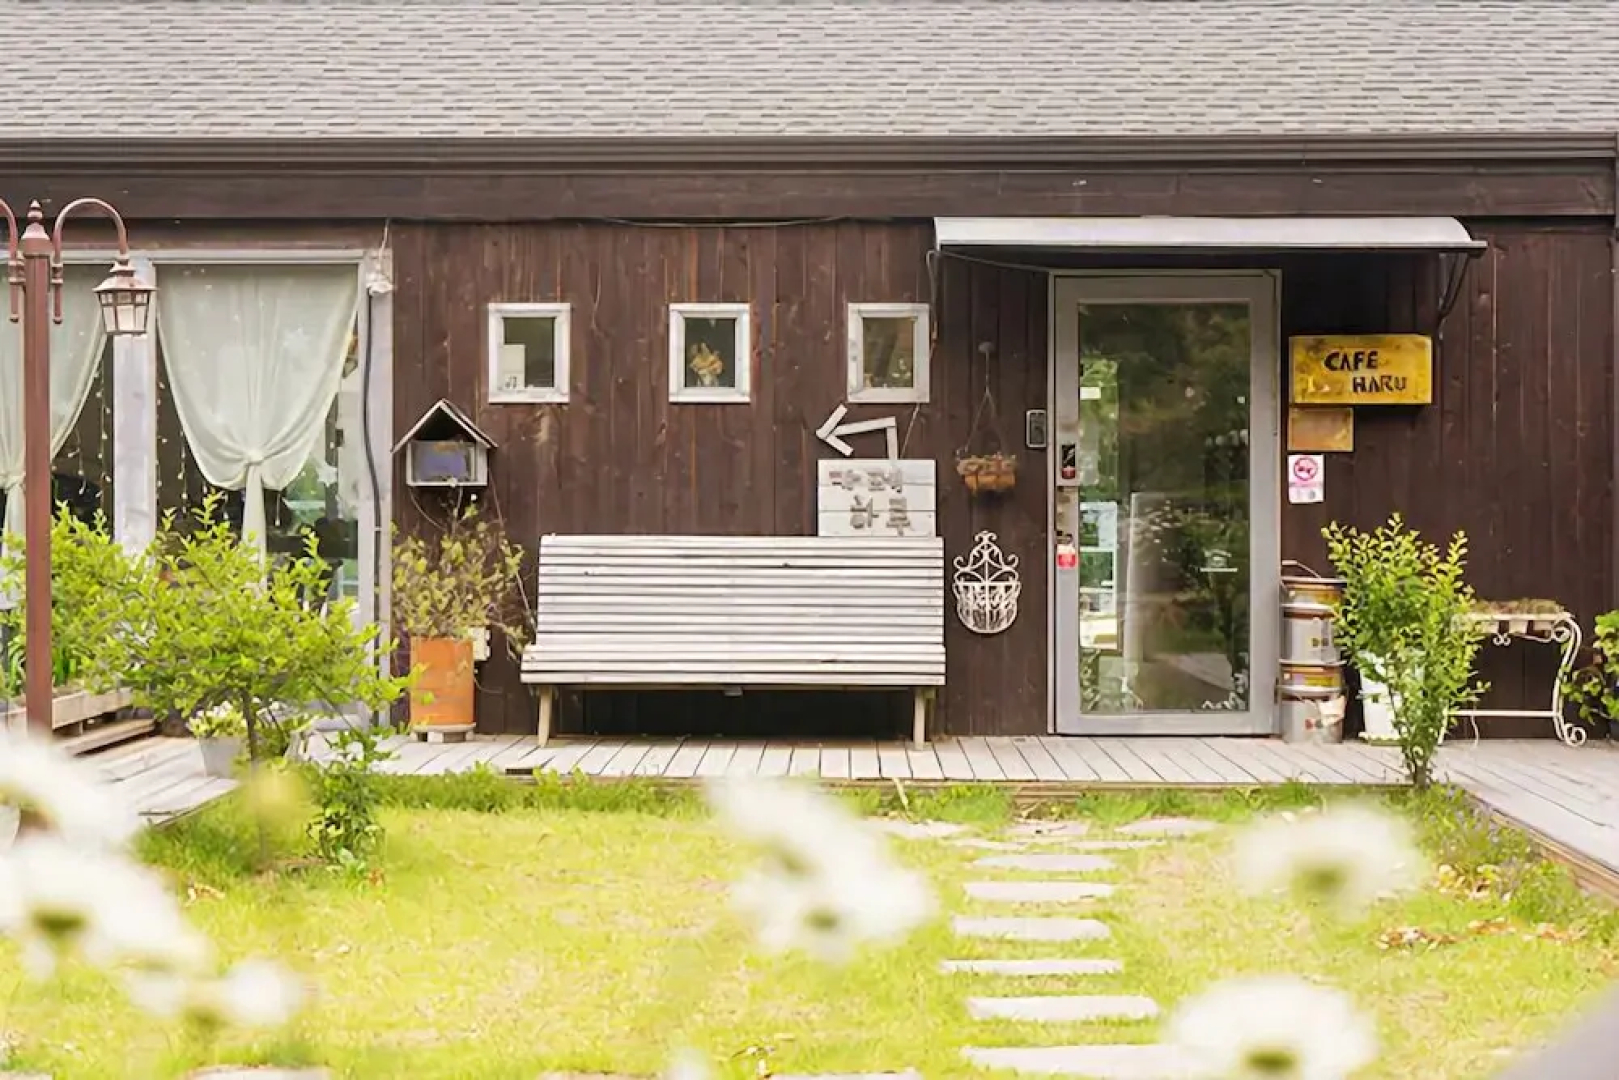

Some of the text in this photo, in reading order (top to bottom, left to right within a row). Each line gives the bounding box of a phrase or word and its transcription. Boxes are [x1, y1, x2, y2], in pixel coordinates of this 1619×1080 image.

[1324, 350, 1378, 371] CAFE
[1353, 375, 1406, 392] HARU
[850, 495, 911, 537] 하루
